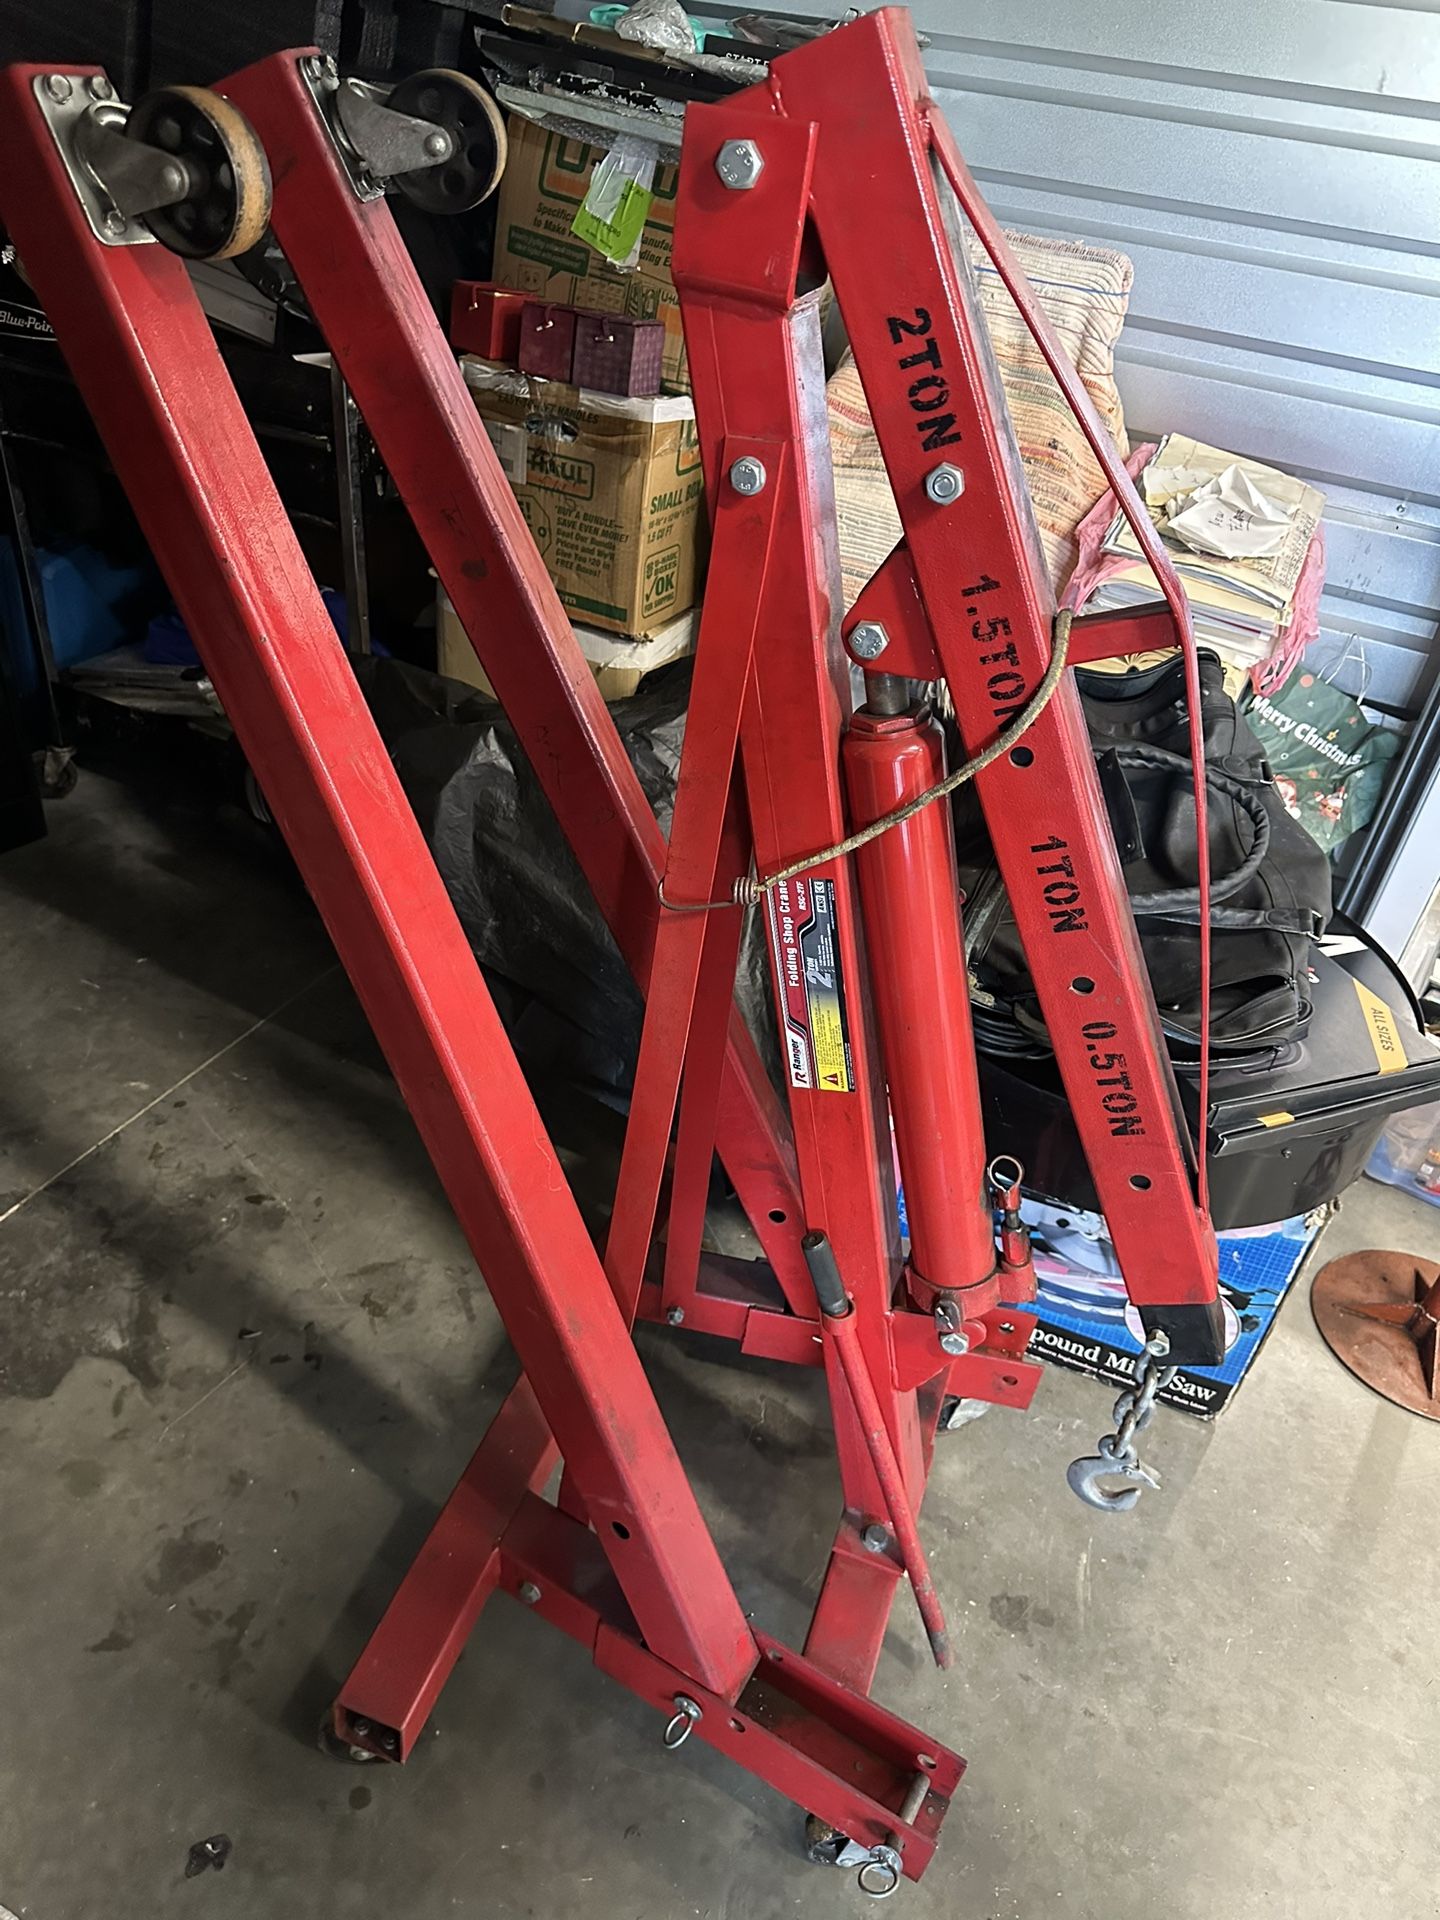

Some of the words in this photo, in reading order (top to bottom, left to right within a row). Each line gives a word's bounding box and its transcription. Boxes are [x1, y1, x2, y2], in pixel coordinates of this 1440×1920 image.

[0, 310, 55, 334] Blue-Poin
[887, 308, 962, 452] 2TON
[557, 404, 599, 424] HANDLES
[650, 488, 682, 515] SMALL
[557, 518, 576, 530] SAVE
[579, 522, 600, 537] EVEN
[600, 527, 629, 544] MORE!
[556, 558, 574, 571] FREE
[656, 571, 675, 596] OK
[1249, 695, 1297, 733] Merry
[779, 880, 791, 913] Crane
[1030, 835, 1088, 933] 1TON
[783, 916, 794, 944] Shop
[786, 947, 801, 987] Folding
[806, 956, 815, 971] TON
[806, 969, 833, 988] 2
[1371, 1007, 1387, 1027] ALL
[1376, 1026, 1395, 1052] SIZES
[791, 1039, 802, 1070] Ranger
[1081, 1021, 1146, 1137] 0.5TON
[1030, 1328, 1100, 1362] pound
[1168, 1374, 1217, 1402] Saw
